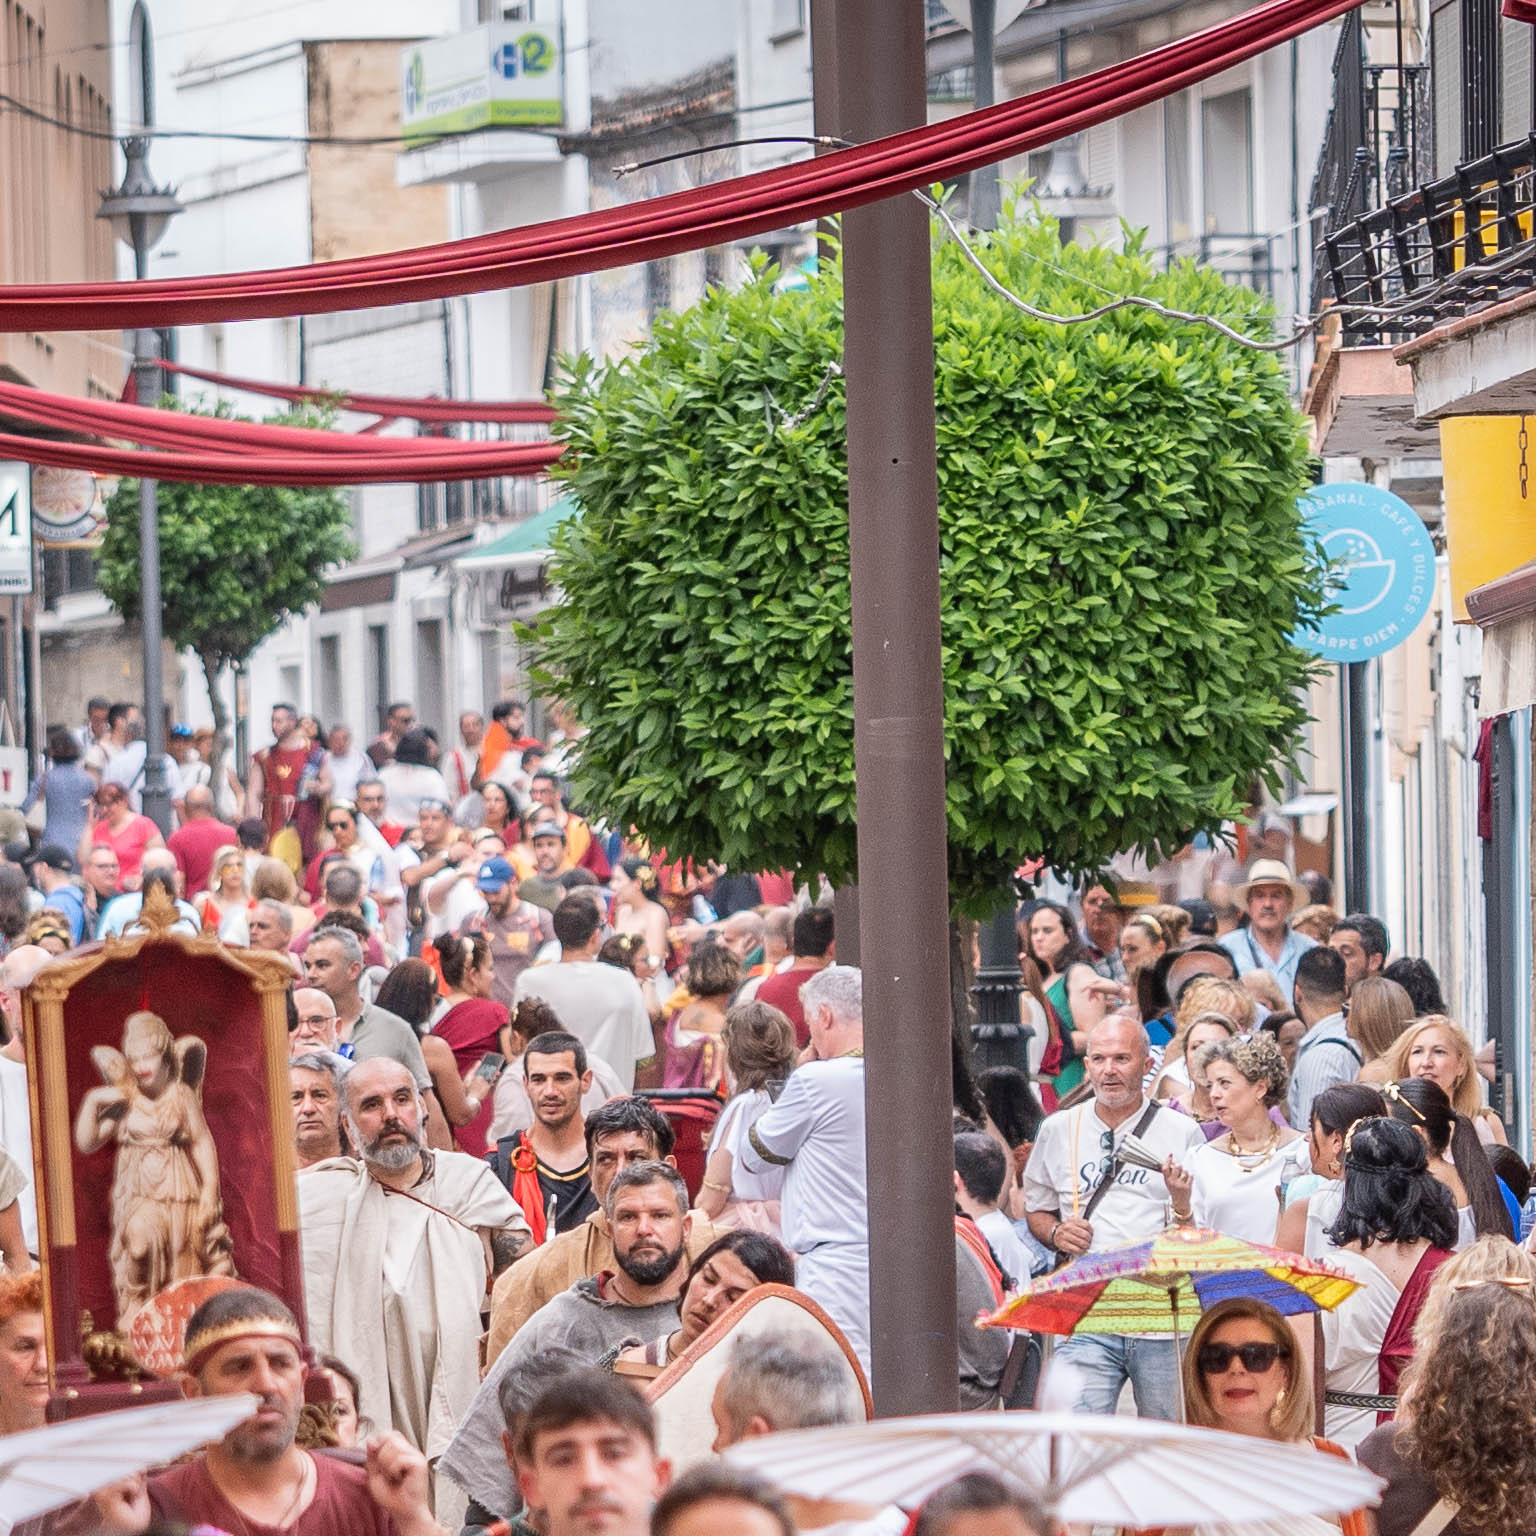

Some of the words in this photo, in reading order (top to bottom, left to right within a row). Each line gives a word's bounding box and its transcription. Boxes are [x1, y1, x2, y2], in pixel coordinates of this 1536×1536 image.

[1404, 554, 1427, 614] DULCES
[1307, 632, 1358, 650] CARPE
[1363, 621, 1400, 647] DIEM
